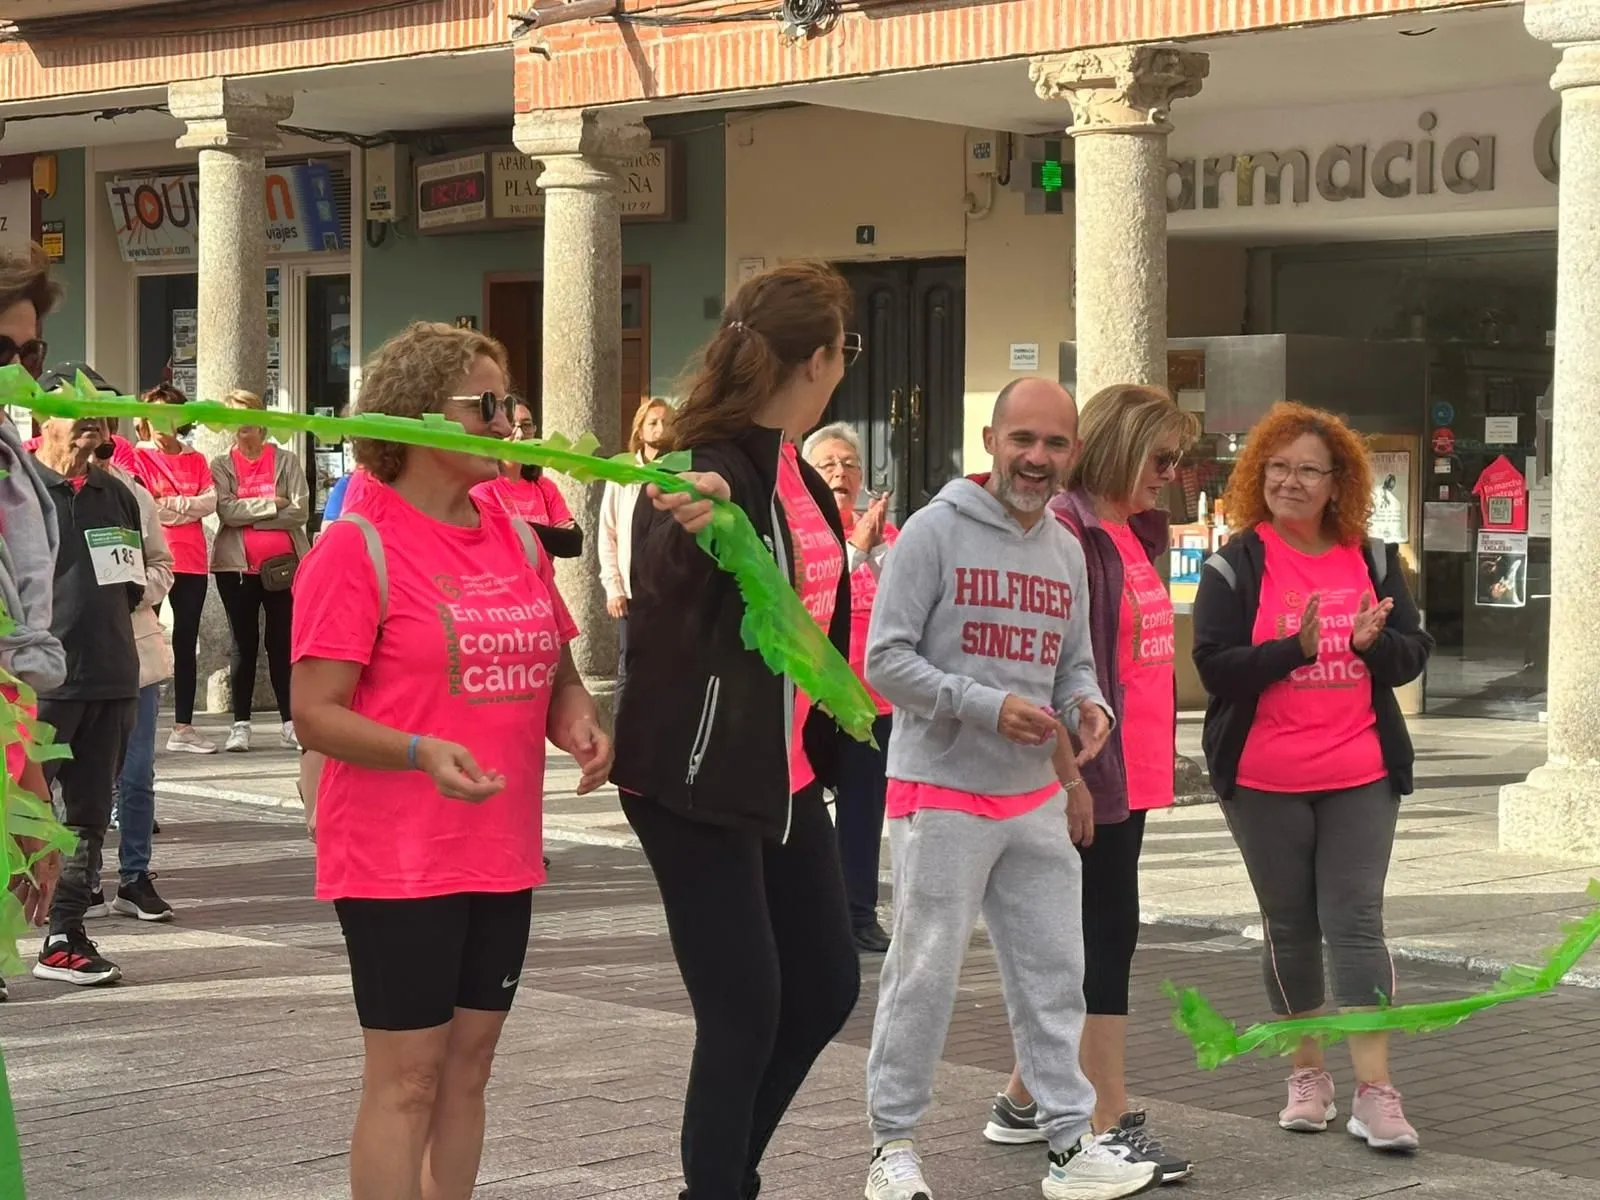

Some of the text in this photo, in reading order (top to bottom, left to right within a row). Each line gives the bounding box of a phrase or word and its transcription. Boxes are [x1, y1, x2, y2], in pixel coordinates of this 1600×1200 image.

[1167, 111, 1496, 212] armacia
[505, 179, 545, 197] PLAZ
[266, 224, 298, 243] viajes
[954, 567, 1073, 620] HILFIGER
[448, 603, 483, 623] En
[459, 628, 551, 655] contra
[961, 620, 1062, 666] SINCE 85
[1140, 630, 1175, 658] cánc
[463, 656, 558, 693] cánce
